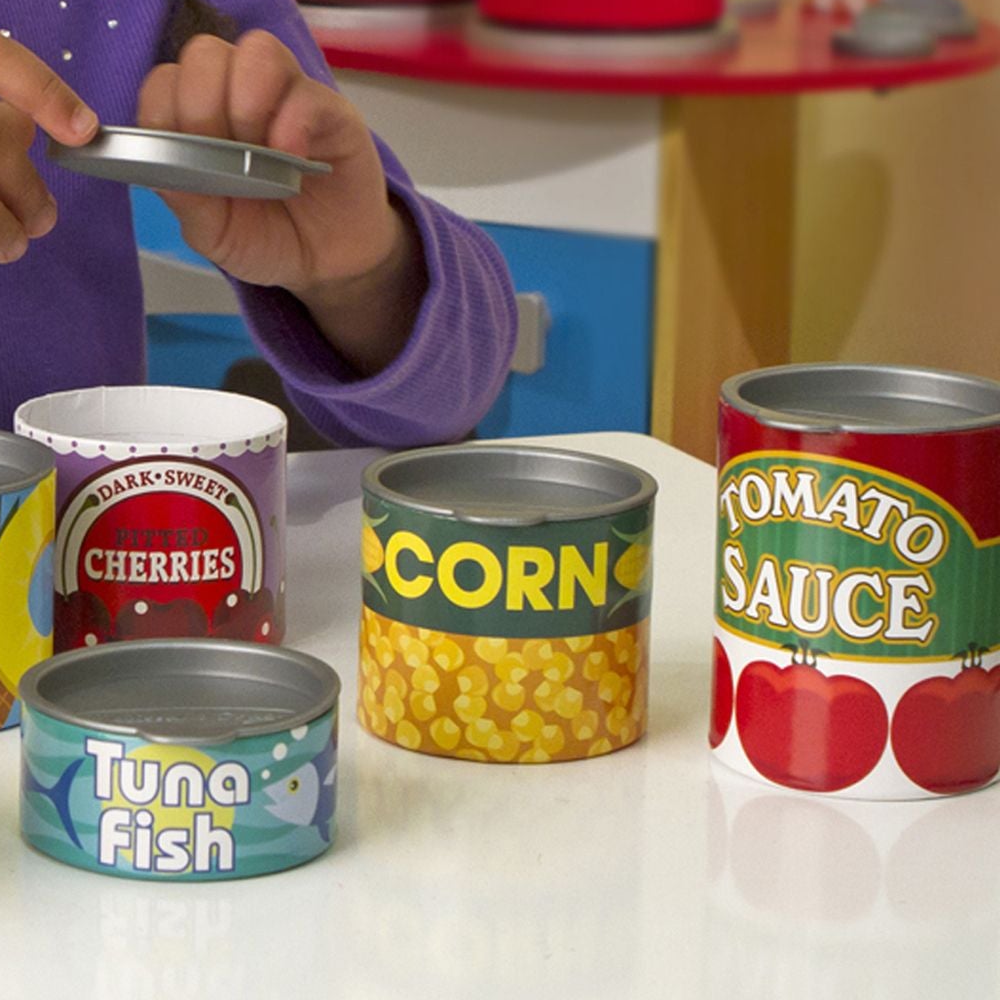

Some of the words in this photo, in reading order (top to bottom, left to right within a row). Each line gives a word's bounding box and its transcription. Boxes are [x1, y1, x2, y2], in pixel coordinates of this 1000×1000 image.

[115, 527, 208, 548] PITTED
[720, 469, 945, 565] TOMATO
[84, 546, 236, 583] CHERRIES
[384, 531, 609, 611] CORN
[720, 544, 935, 642] SAUCE
[84, 736, 252, 808] Tuna
